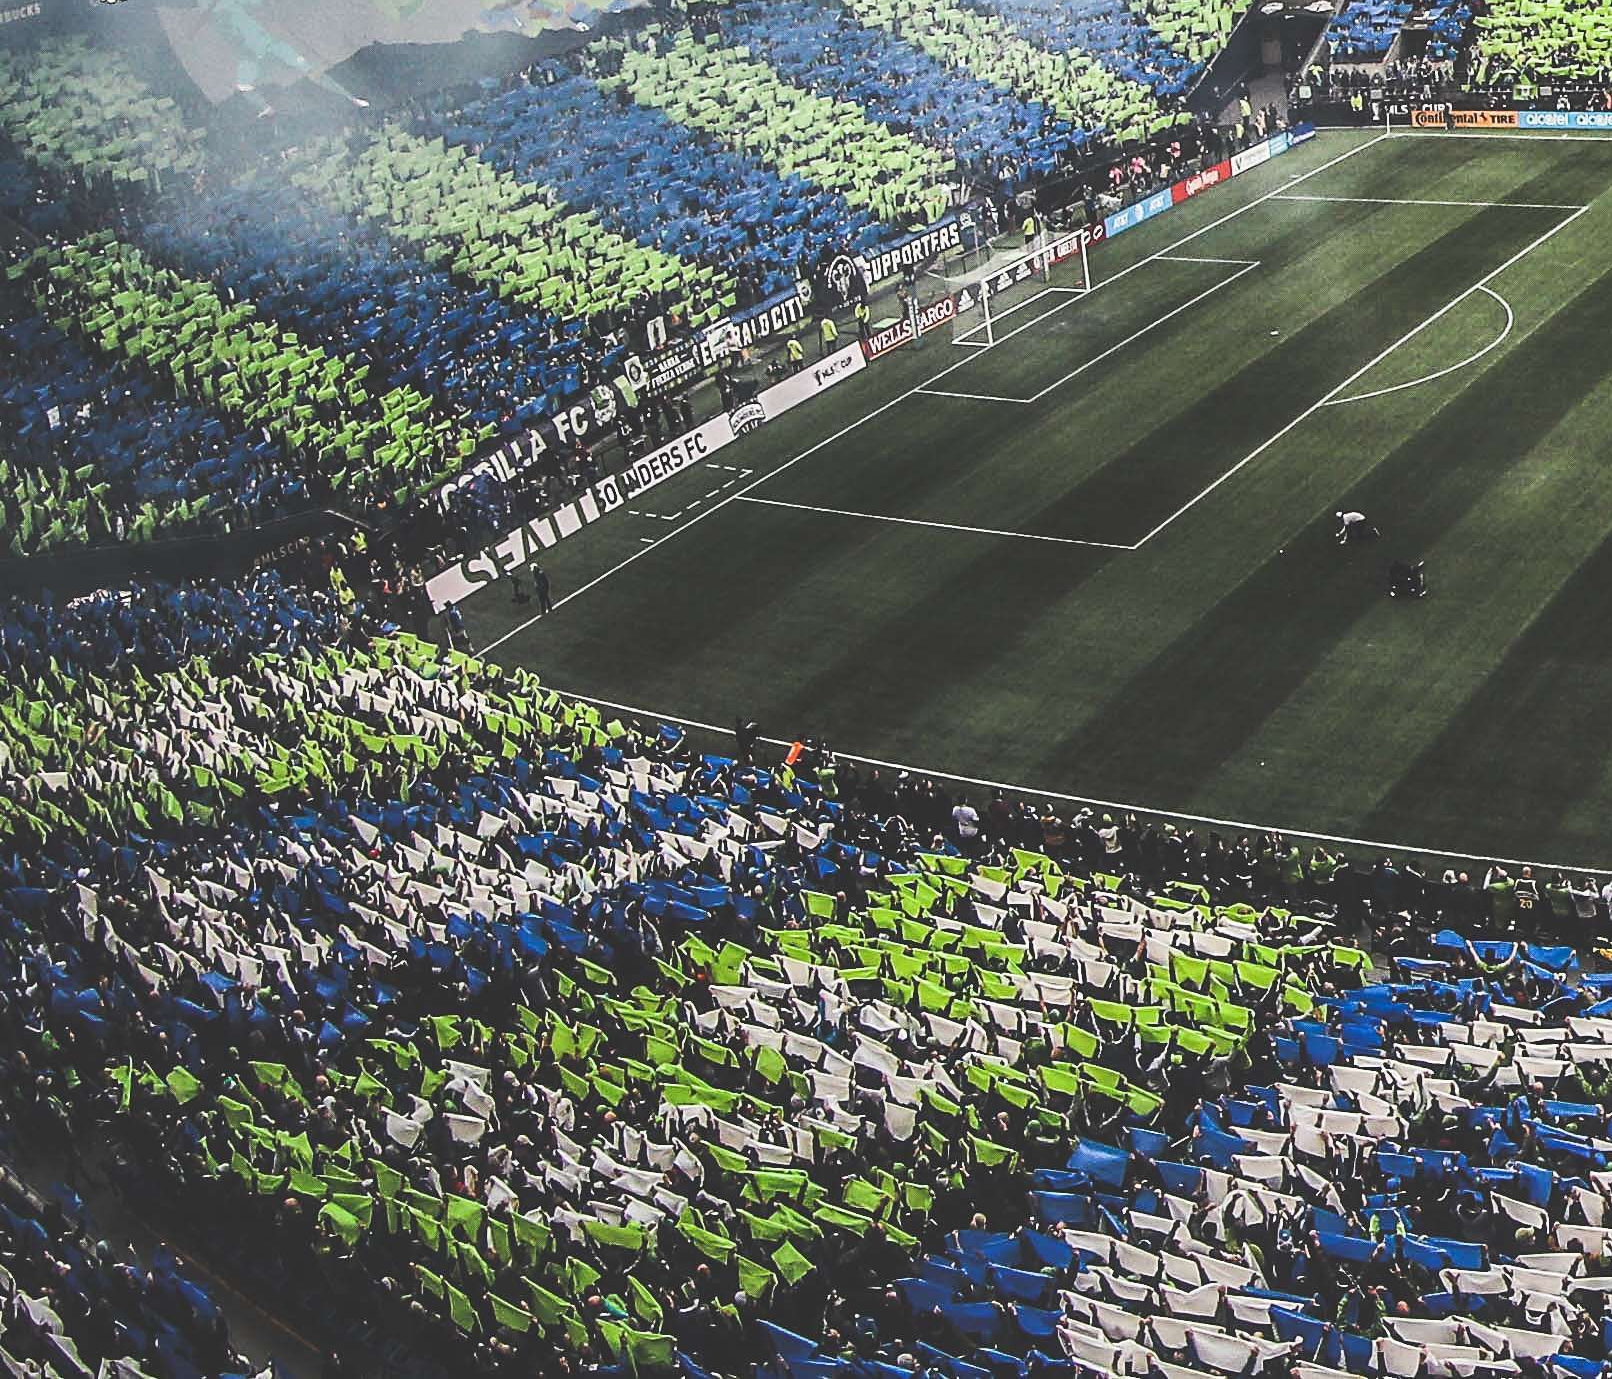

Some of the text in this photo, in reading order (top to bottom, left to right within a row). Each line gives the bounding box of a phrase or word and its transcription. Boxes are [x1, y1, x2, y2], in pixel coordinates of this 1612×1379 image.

[1415, 112, 1516, 127] Contiental TIRE
[862, 222, 961, 283] SUPPORTERS
[773, 297, 805, 331] CITY
[868, 299, 954, 353] WELLS ARGO
[552, 406, 588, 443] FC
[685, 433, 708, 461] FC
